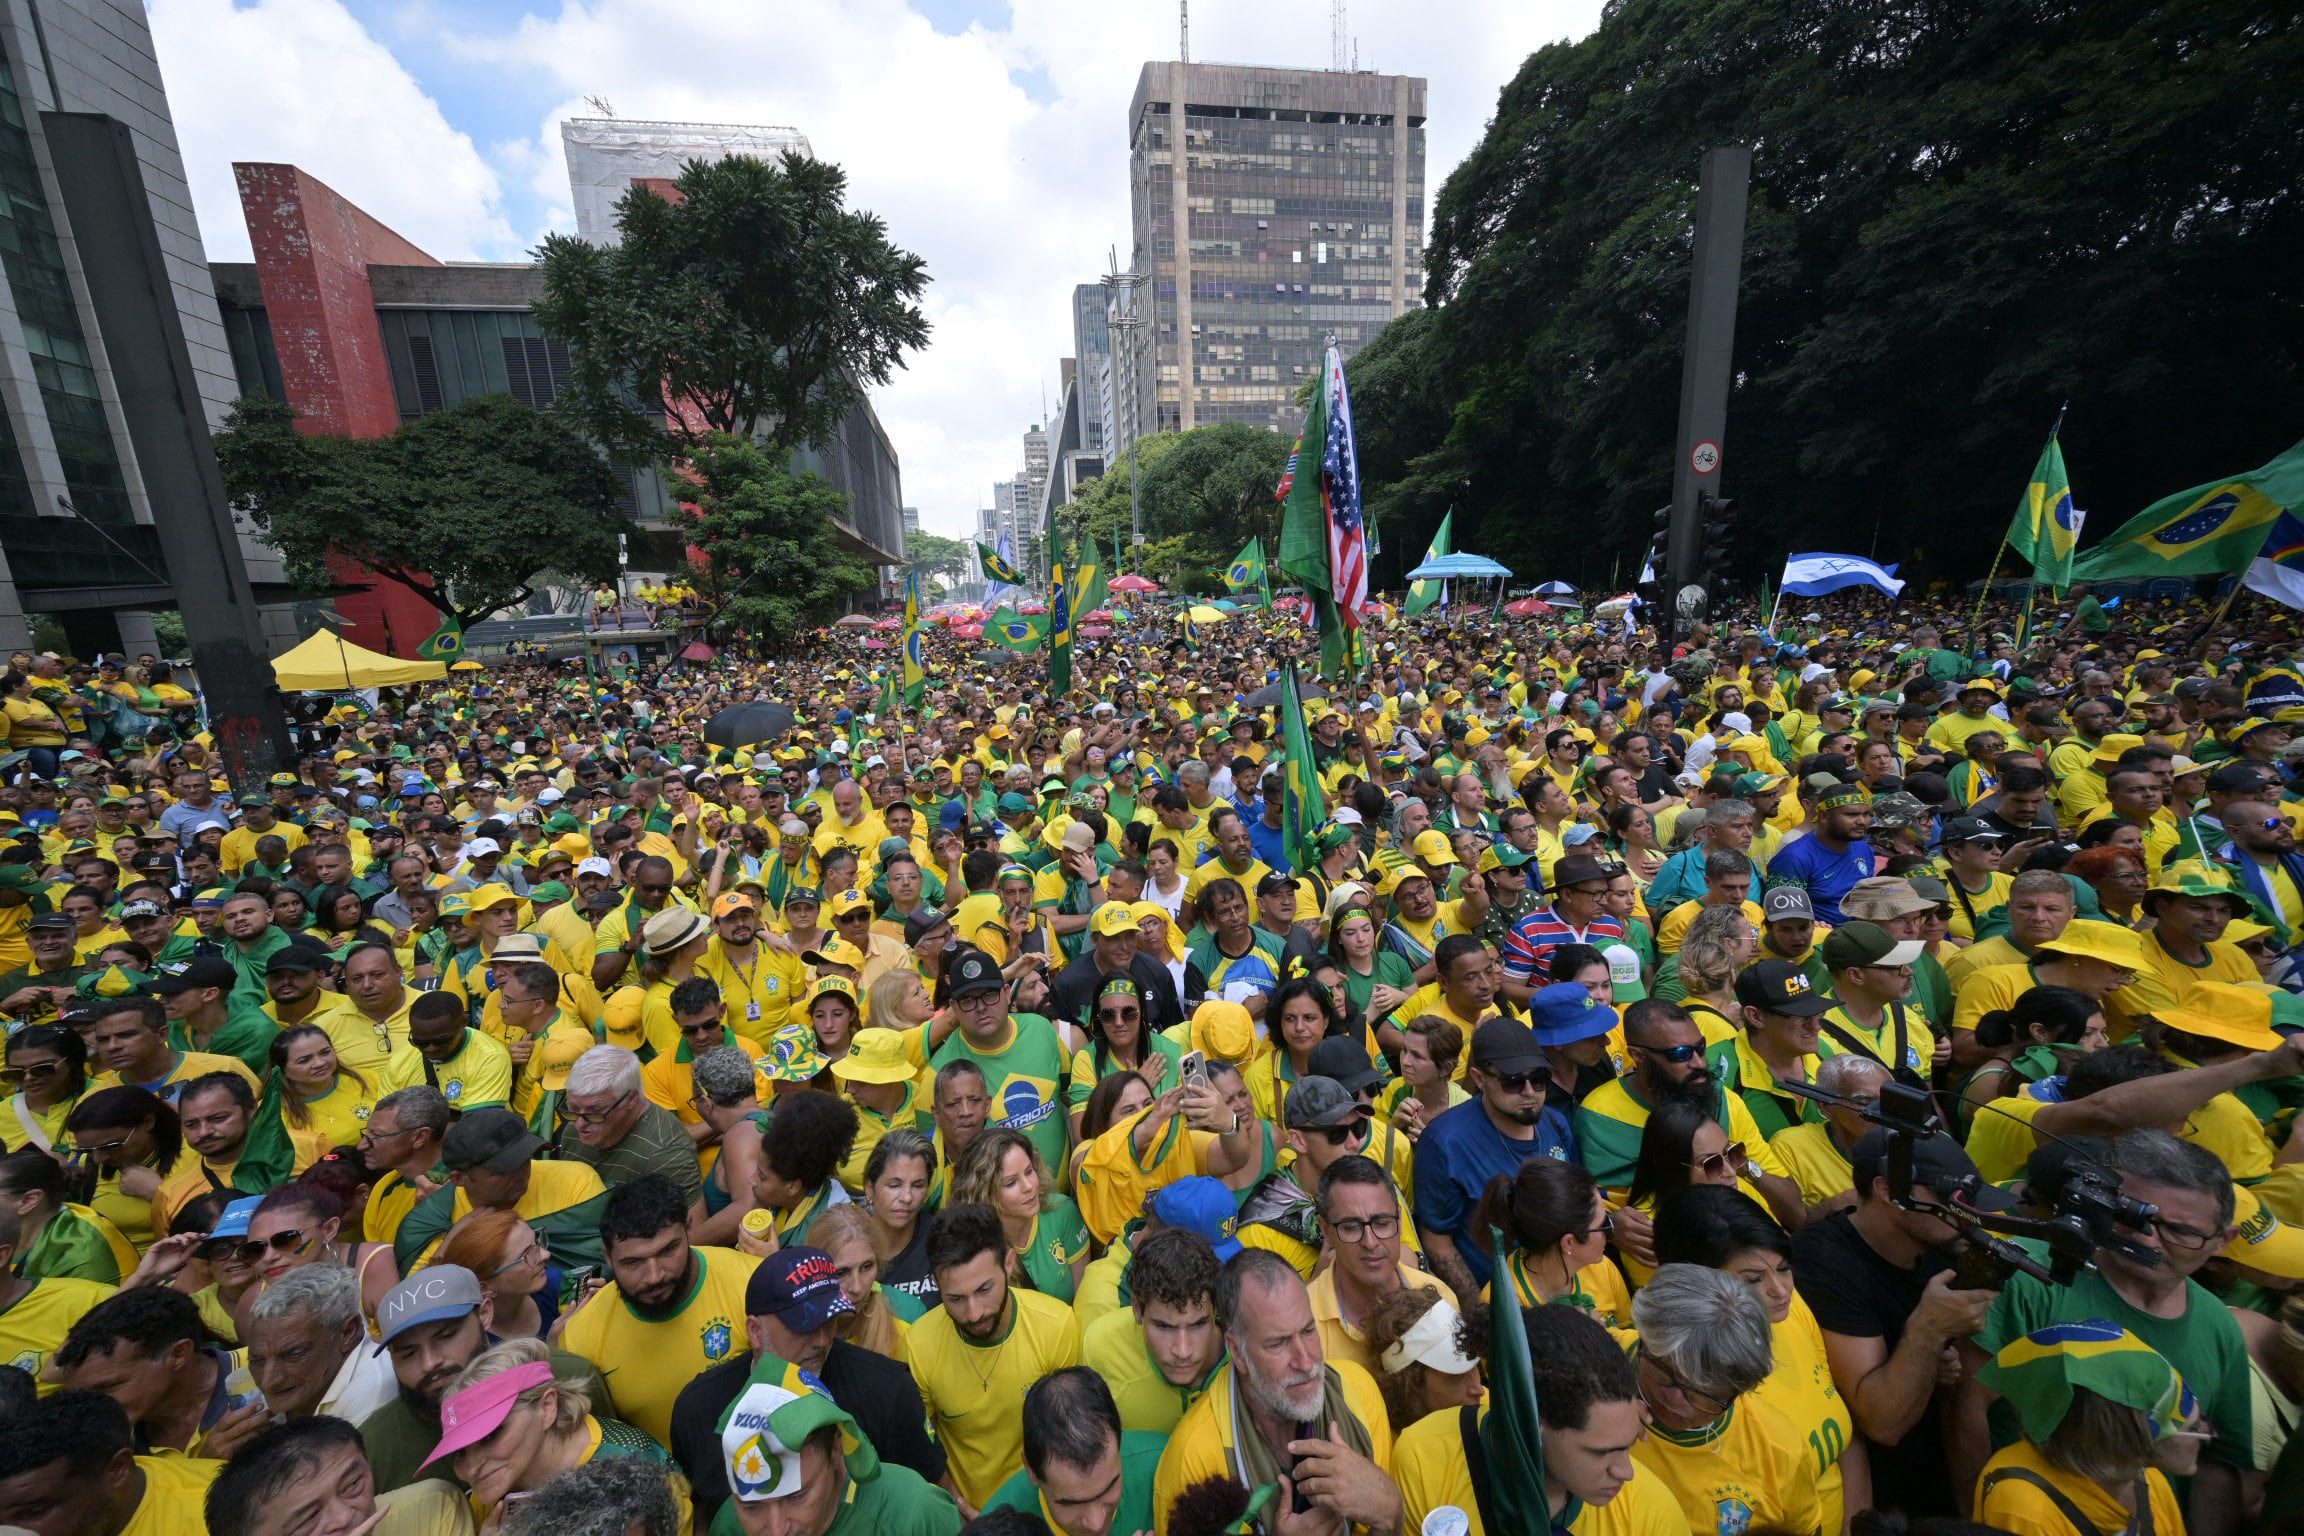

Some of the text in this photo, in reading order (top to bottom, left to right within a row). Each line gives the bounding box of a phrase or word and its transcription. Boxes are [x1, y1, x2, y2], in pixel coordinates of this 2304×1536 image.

[1774, 894, 1804, 909] ON
[998, 1100, 1056, 1129] ATRIOTA
[1950, 1204, 1982, 1226] RONIN
[785, 1259, 838, 1287] TRUMP
[792, 1286, 808, 1299] KEEP
[808, 1279, 830, 1291] AMERICA
[389, 1279, 446, 1320] NYC
[1808, 1418, 1844, 1475] 10
[1727, 1517, 1743, 1527] CBF
